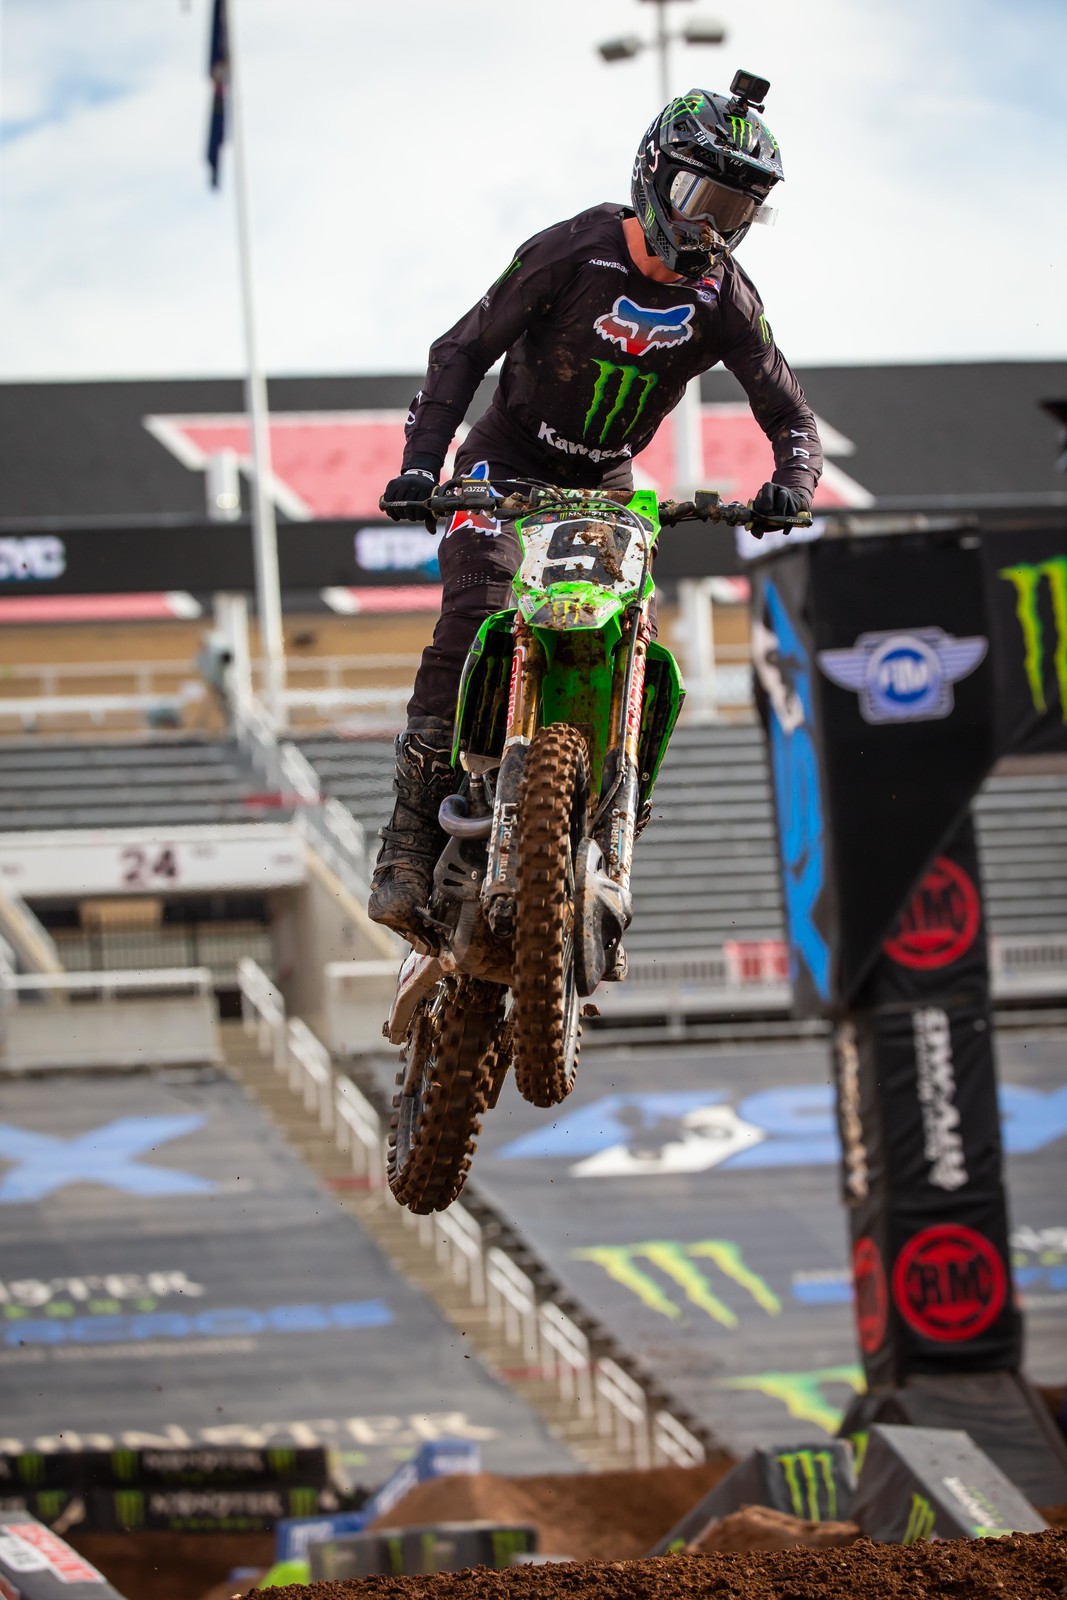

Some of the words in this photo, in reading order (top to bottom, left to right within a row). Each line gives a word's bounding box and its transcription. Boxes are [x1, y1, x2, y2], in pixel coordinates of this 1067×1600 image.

[693, 130, 711, 147] FOX
[729, 158, 745, 168] FOX
[120, 846, 178, 887] 24
